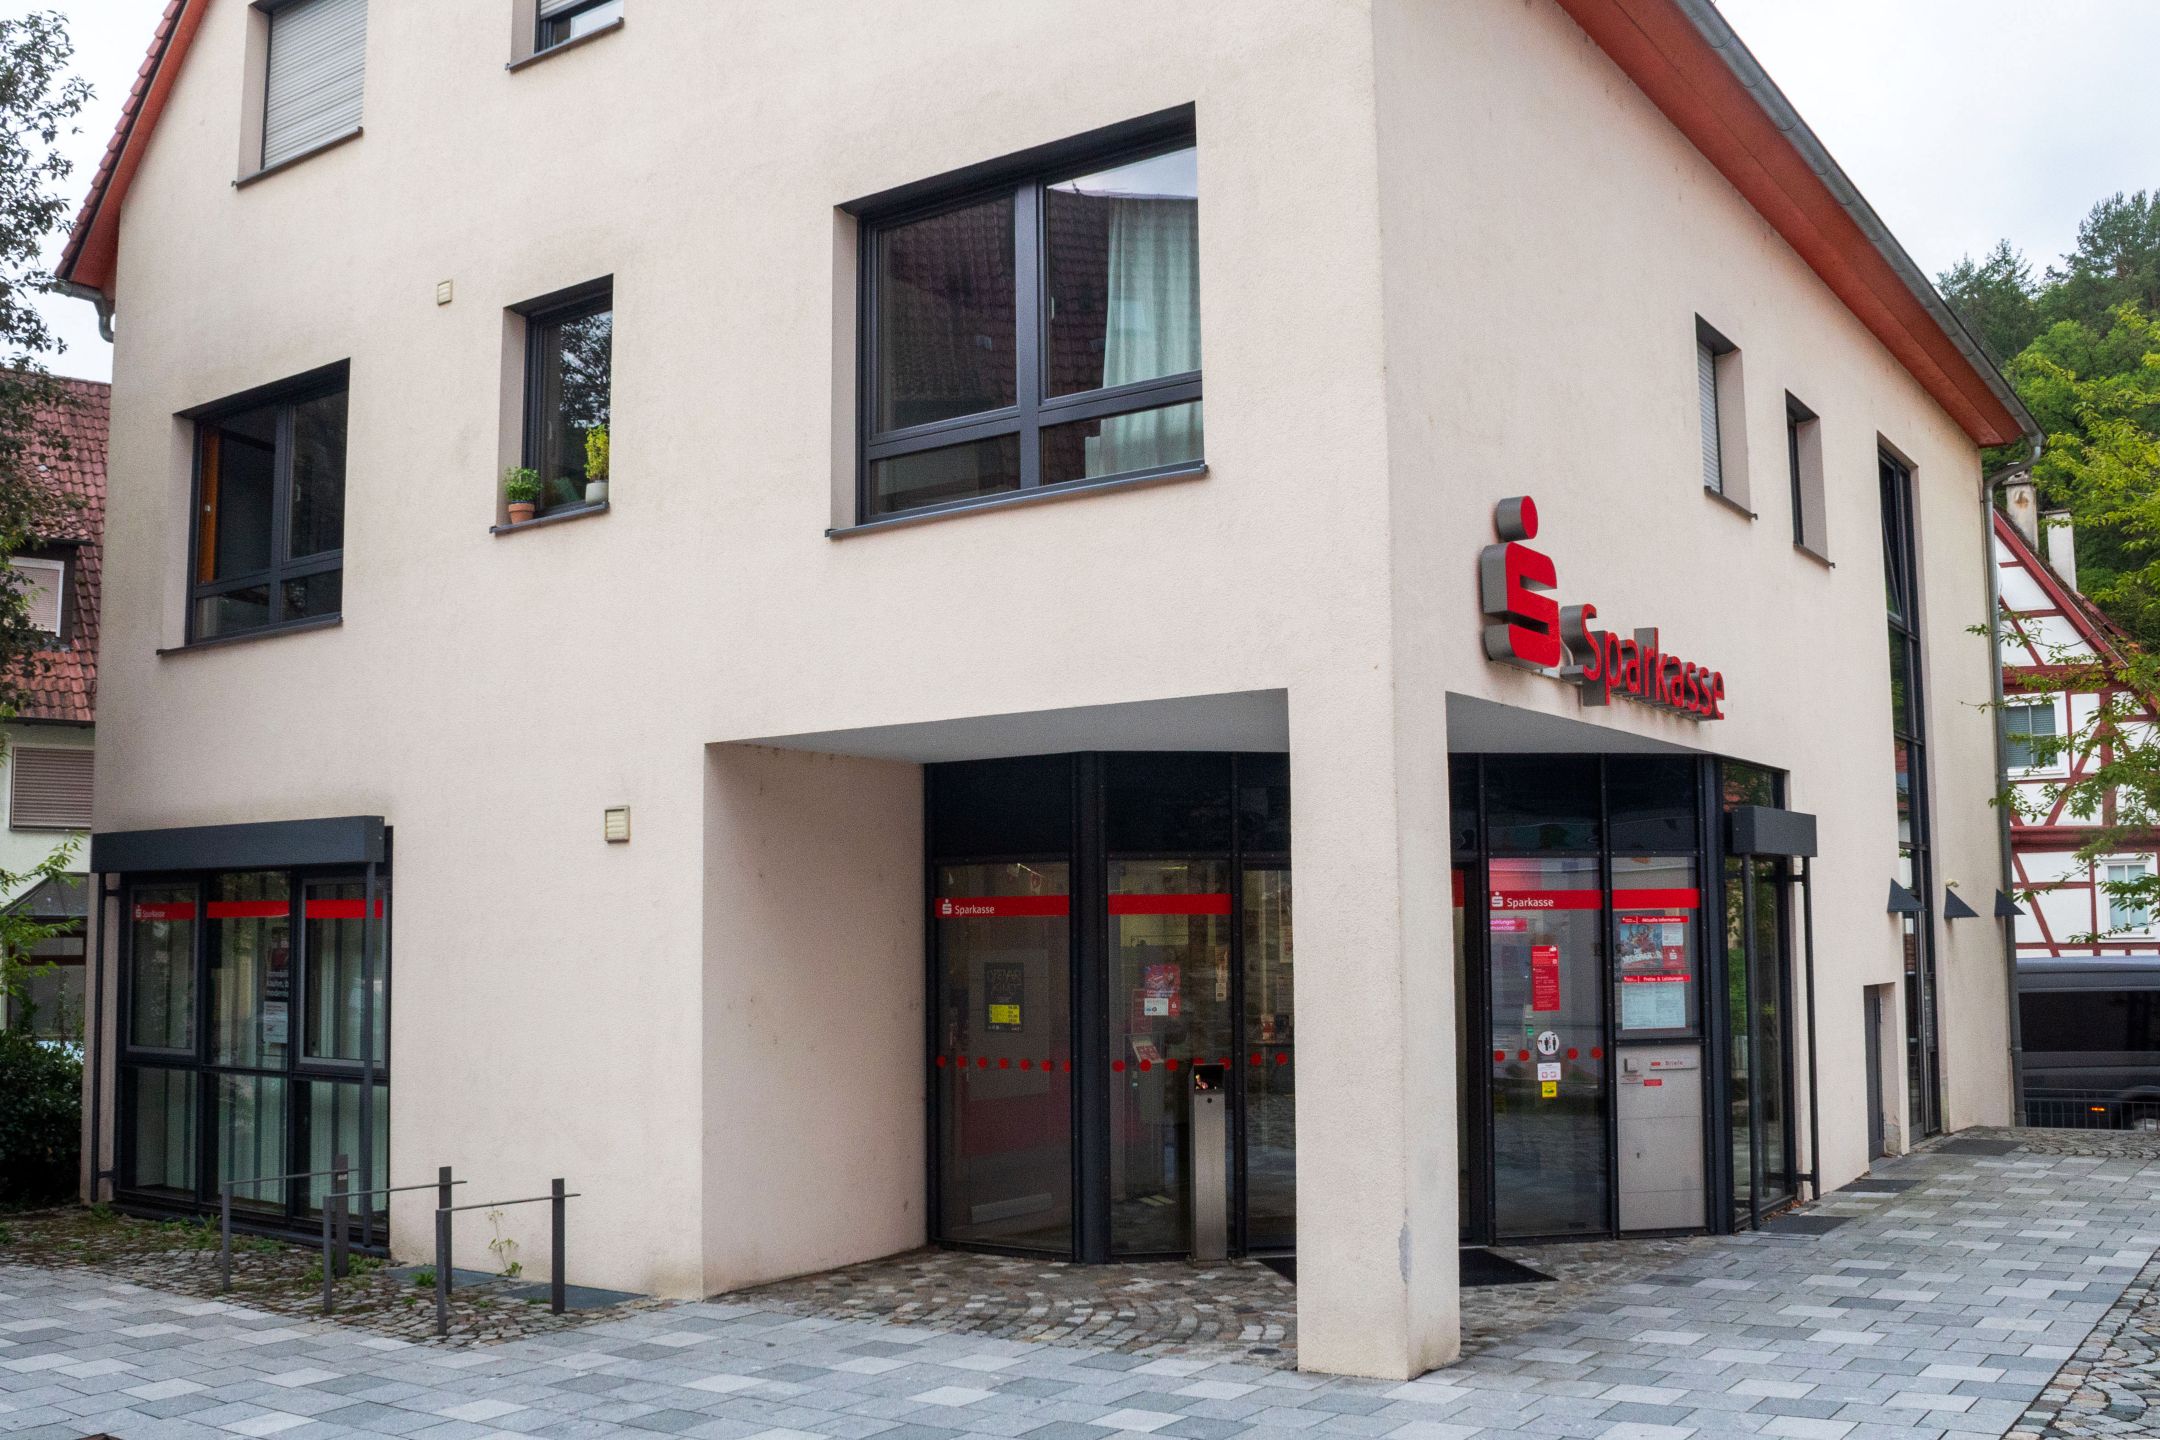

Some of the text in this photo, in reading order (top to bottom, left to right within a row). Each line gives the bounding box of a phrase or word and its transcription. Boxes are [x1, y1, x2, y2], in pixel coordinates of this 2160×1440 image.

[1568, 602, 1725, 721] Sparkasse
[1506, 897, 1554, 909] Sparkasse
[954, 904, 995, 916] Sparkasse
